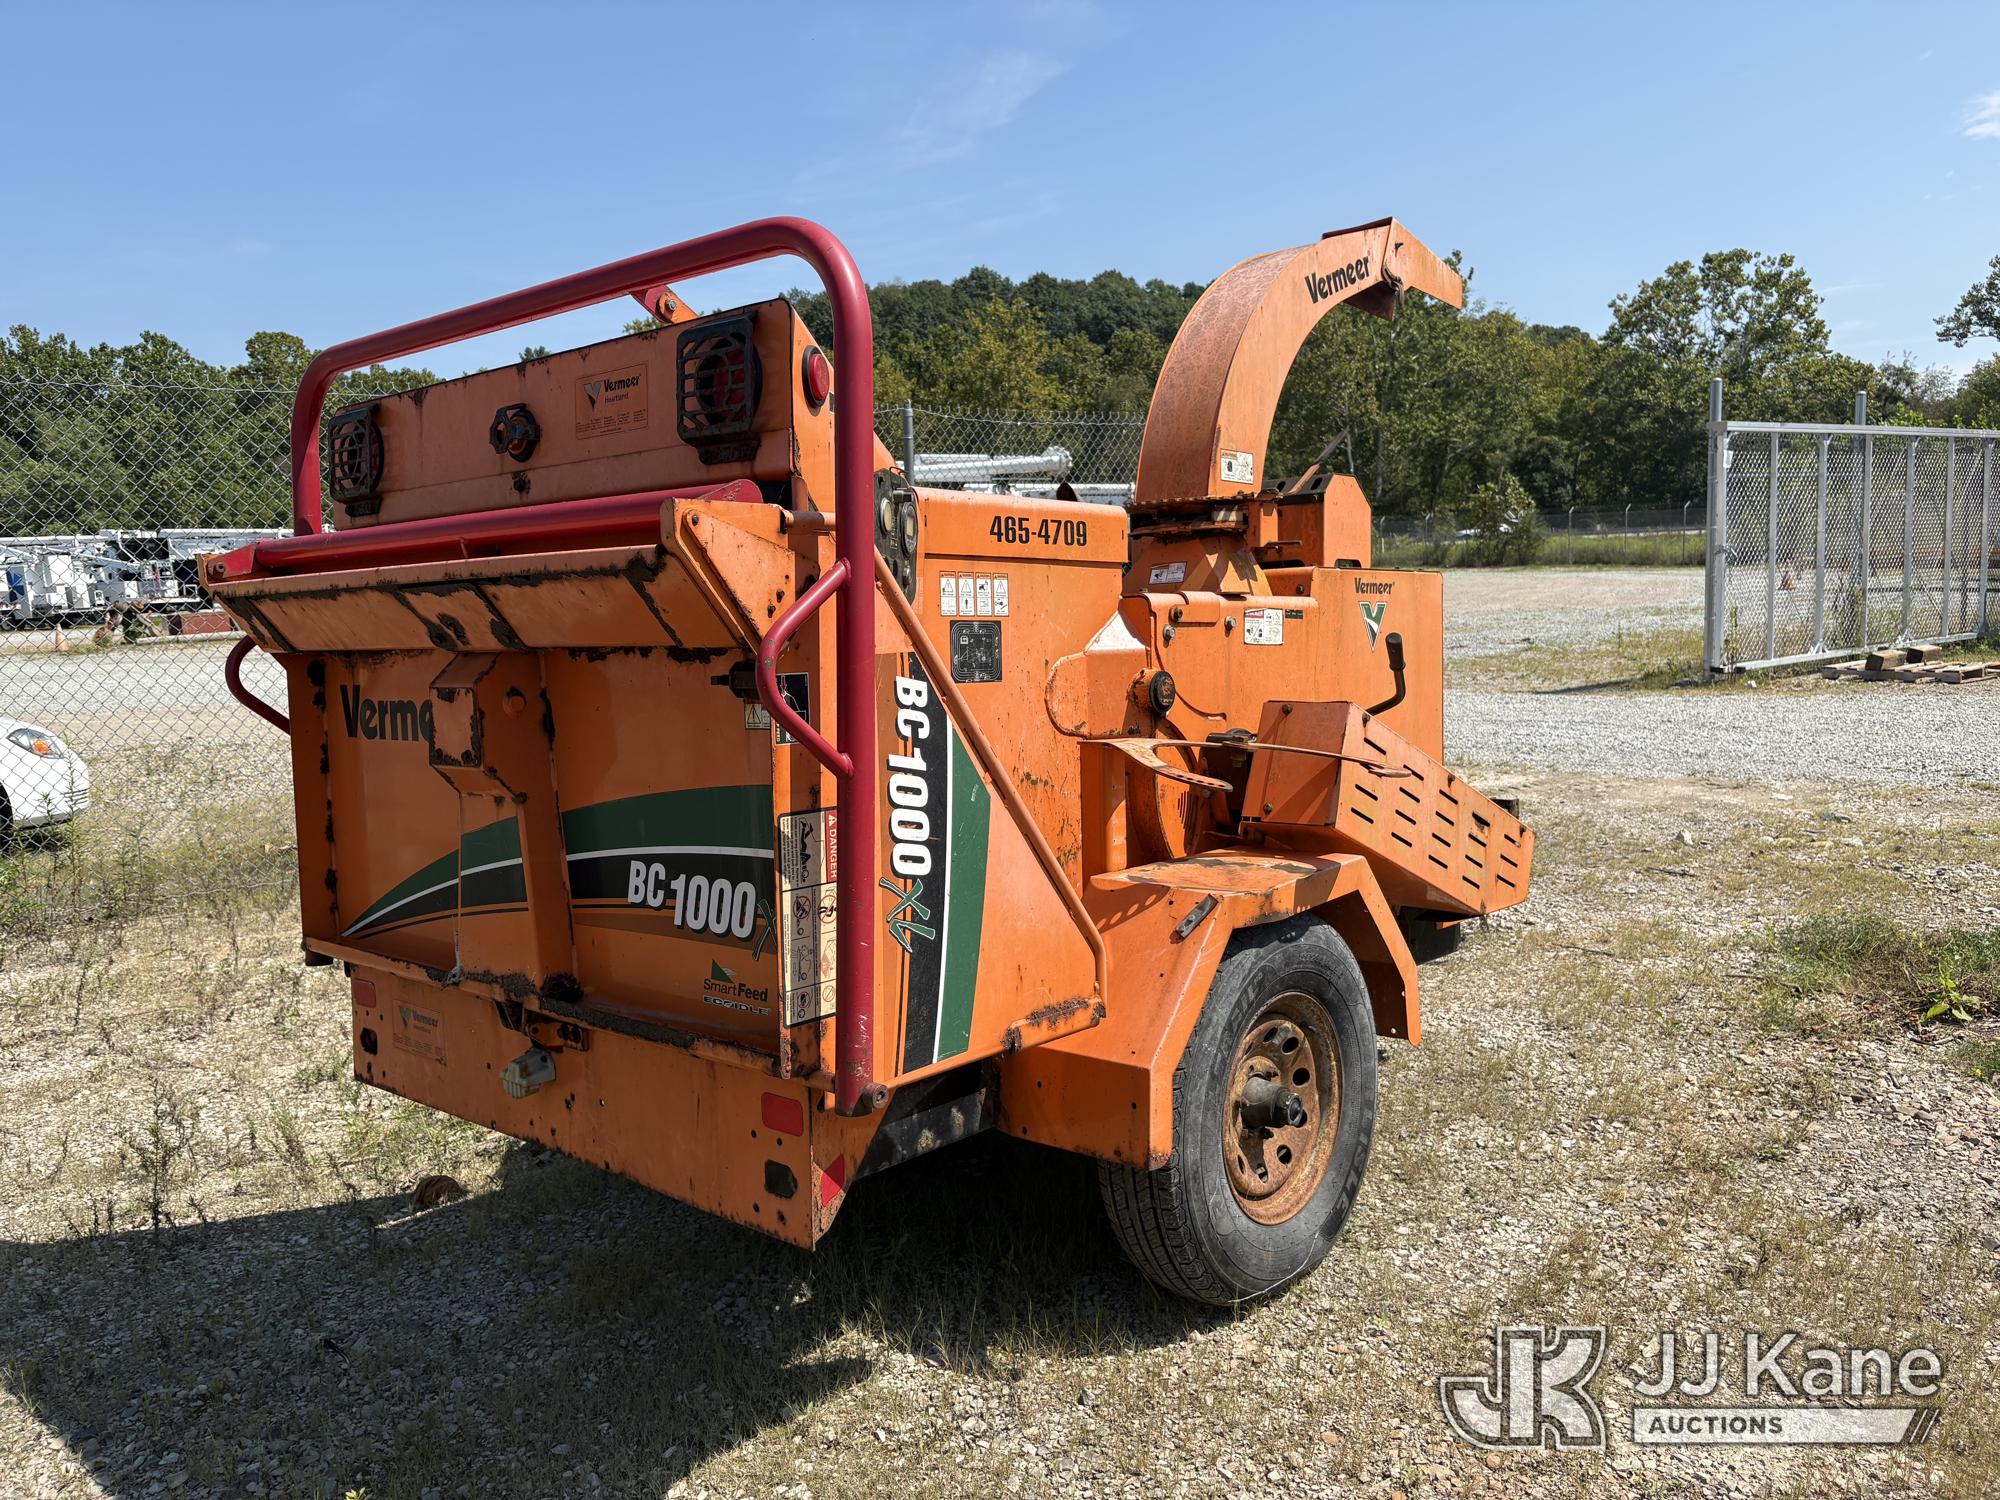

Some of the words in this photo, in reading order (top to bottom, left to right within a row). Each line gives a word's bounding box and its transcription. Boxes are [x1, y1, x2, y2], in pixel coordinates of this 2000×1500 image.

[1304, 256, 1369, 304] Vermeer
[603, 375, 640, 392] Vermeer
[990, 515, 1088, 546] 465-4709
[1354, 577, 1393, 595] Vermeer
[829, 830, 838, 879] DANGER
